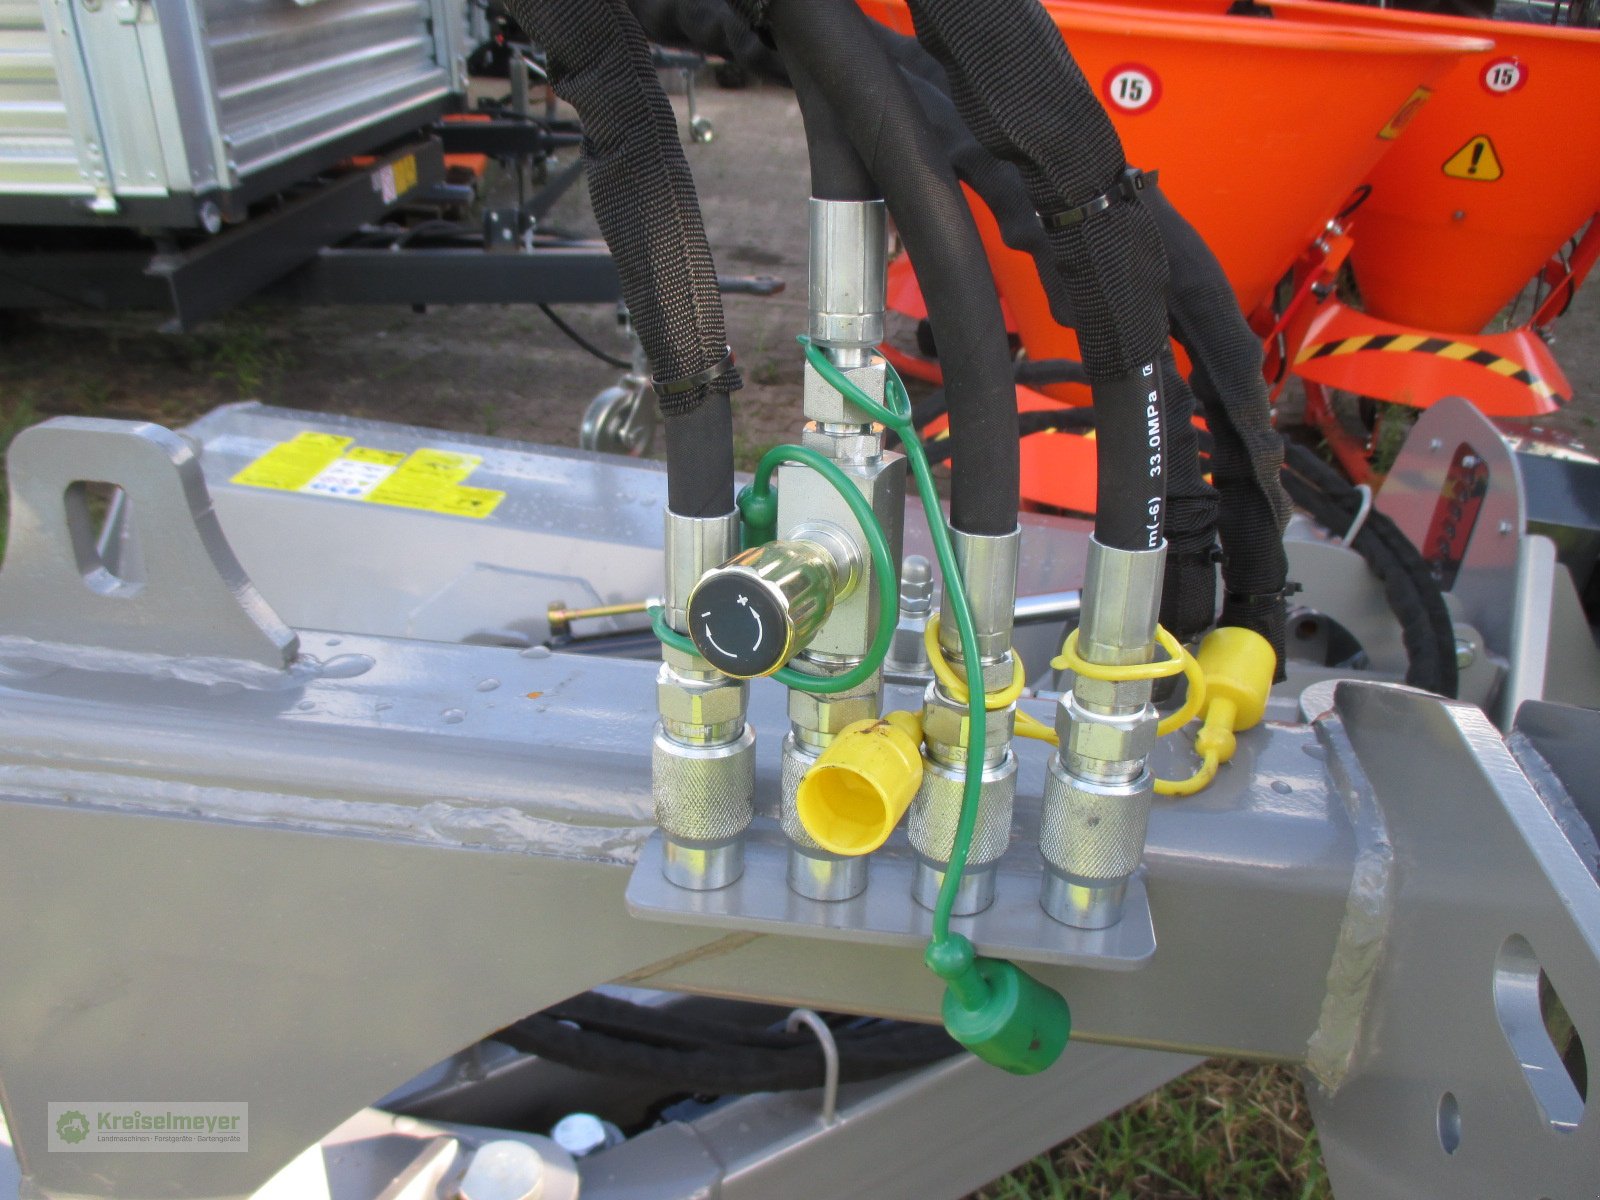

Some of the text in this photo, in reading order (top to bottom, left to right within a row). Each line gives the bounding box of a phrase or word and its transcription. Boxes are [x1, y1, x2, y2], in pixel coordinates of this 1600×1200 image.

[1119, 77, 1144, 101] 15
[1493, 68, 1514, 86] 15
[1146, 390, 1161, 477] 33.0MPa
